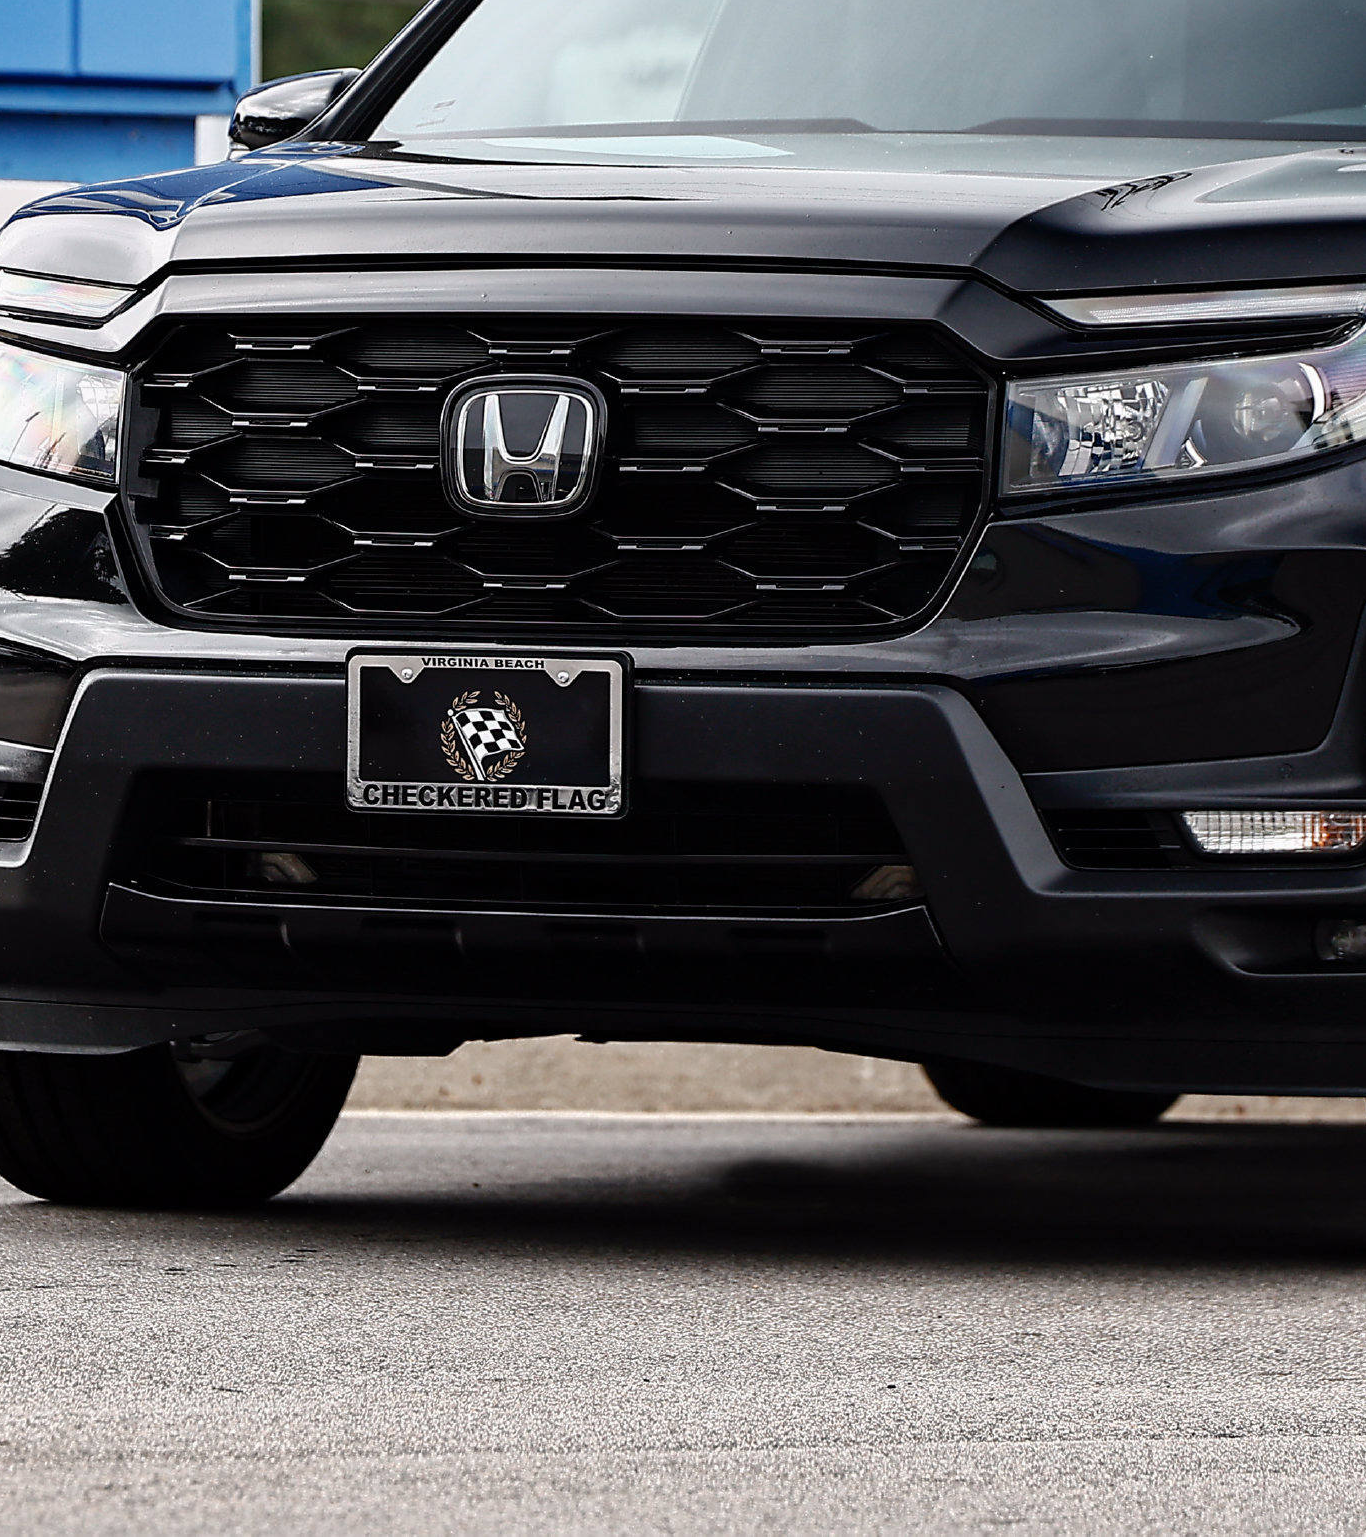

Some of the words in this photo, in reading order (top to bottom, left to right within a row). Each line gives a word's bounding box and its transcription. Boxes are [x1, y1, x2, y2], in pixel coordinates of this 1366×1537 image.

[421, 657, 490, 668] VIRGINIA
[494, 659, 545, 669] BEACH
[363, 784, 528, 809] CHECKERED
[536, 789, 607, 811] FLAG
